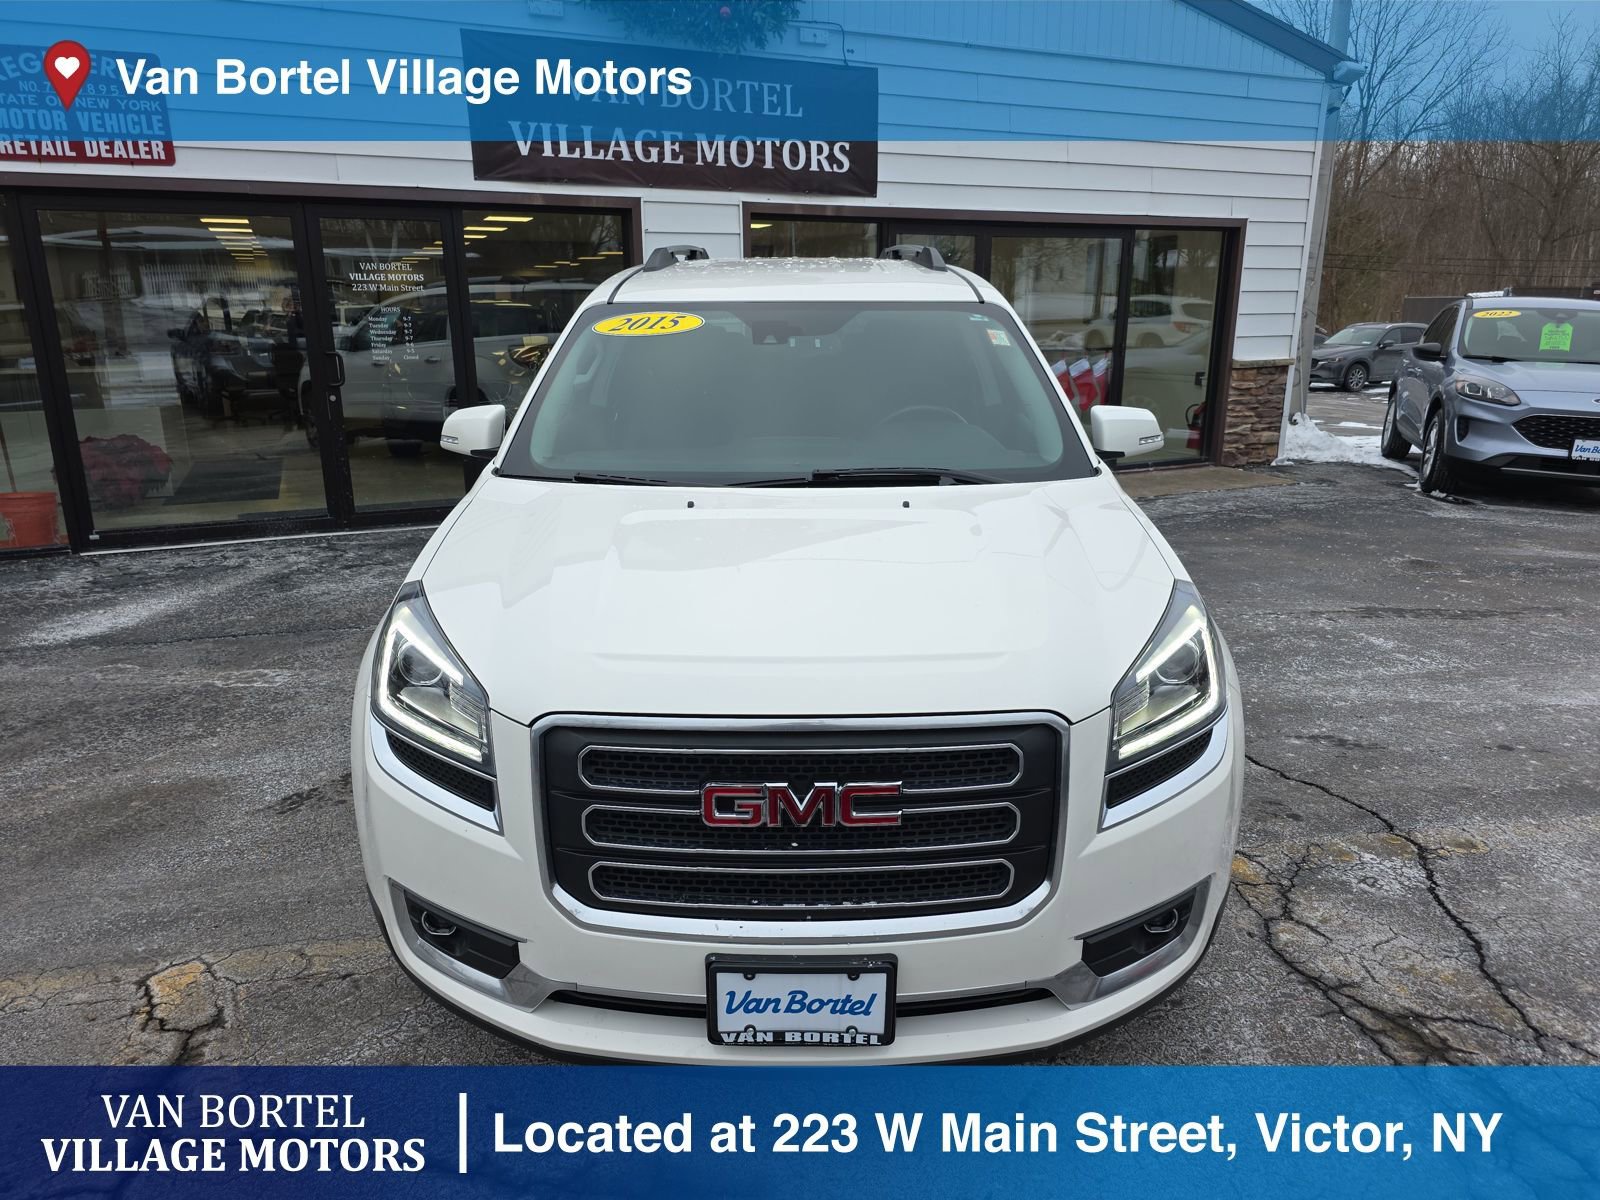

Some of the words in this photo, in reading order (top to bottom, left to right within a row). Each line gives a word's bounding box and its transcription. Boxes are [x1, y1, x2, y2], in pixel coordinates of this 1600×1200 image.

[76, 97, 109, 109] NEW
[117, 99, 162, 112] YORK
[76, 111, 166, 135] VEHICLE
[0, 133, 77, 156] RETAIL
[83, 136, 166, 160] DEALER
[508, 120, 684, 165] VILLAGE
[695, 133, 850, 173] MOTORS
[359, 262, 377, 271] VAN
[380, 263, 412, 271] BORTEL
[349, 273, 386, 281] VILLAGE
[388, 273, 424, 281] MOTORS
[352, 283, 367, 291] 223
[368, 283, 378, 291] W
[400, 284, 424, 292] Street
[607, 315, 687, 332] 2015
[701, 781, 902, 828] GMC
[720, 1031, 774, 1043] VAN
[784, 1032, 882, 1045] BORTEL
